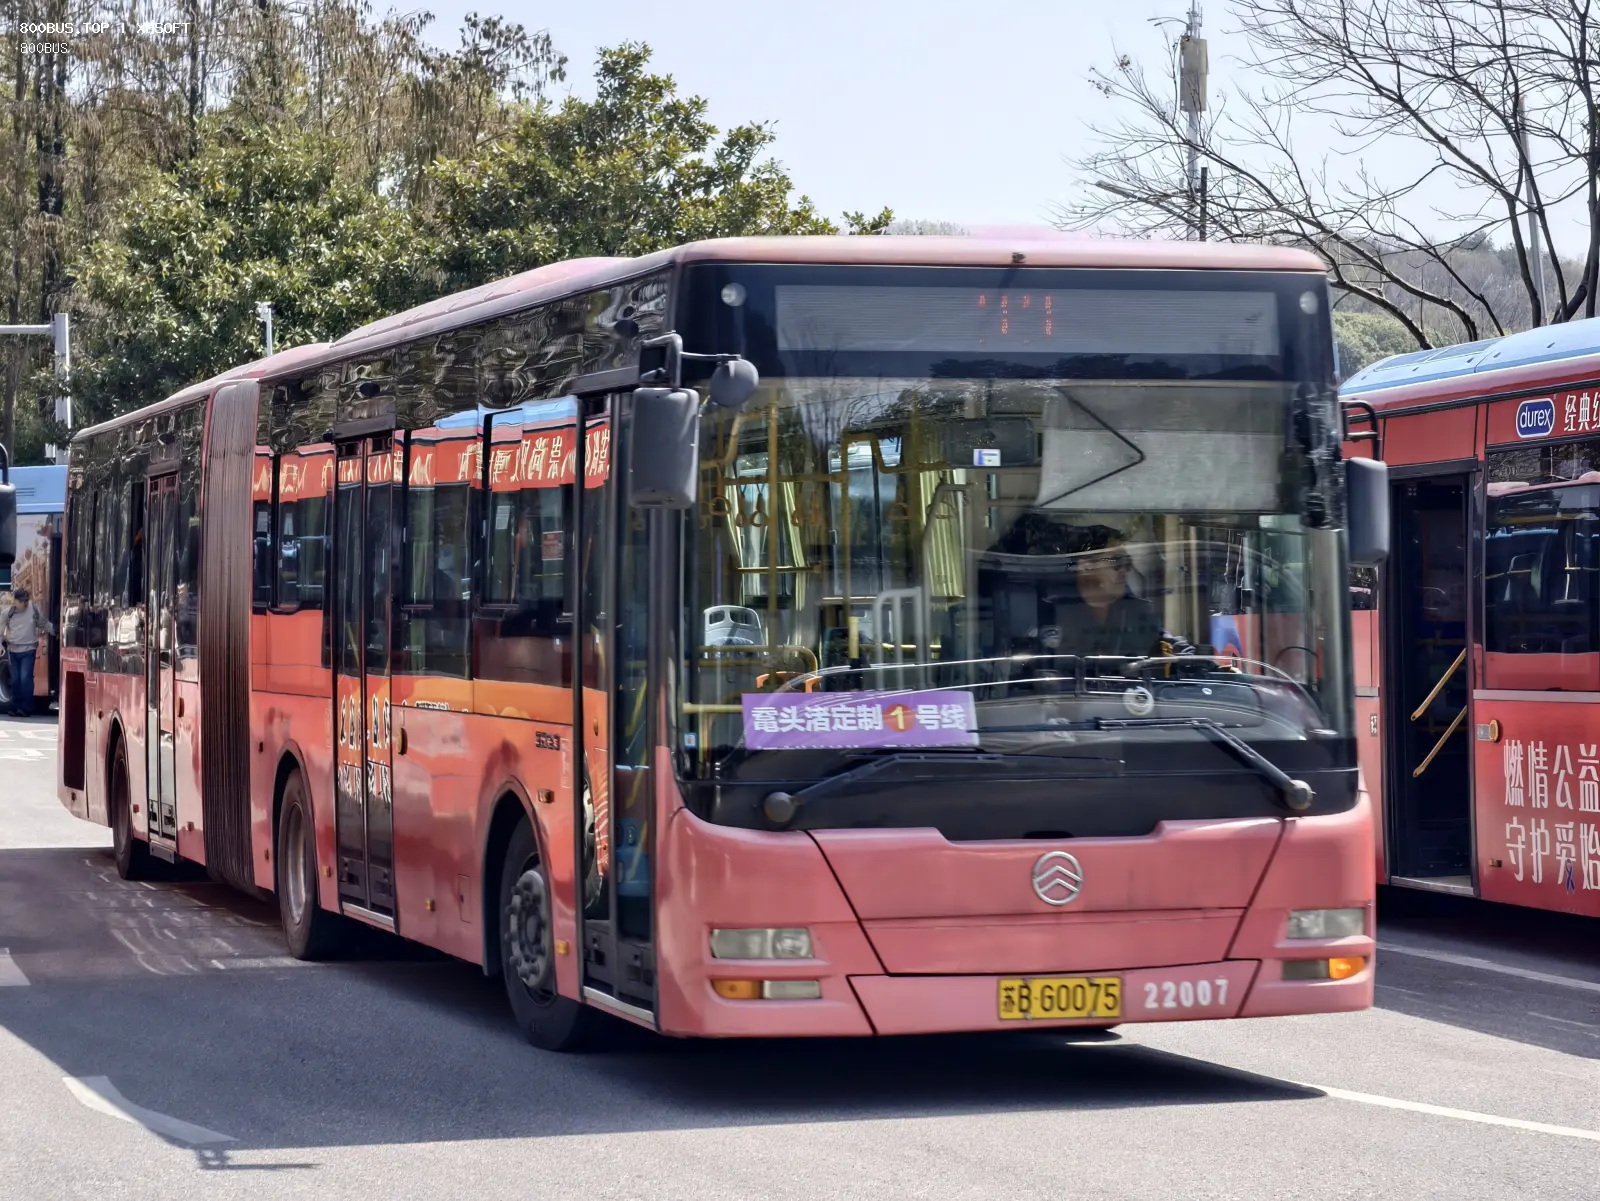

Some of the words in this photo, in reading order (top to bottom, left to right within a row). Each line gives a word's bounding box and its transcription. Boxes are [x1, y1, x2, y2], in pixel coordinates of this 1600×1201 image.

[1519, 405, 1552, 429] durex
[1563, 391, 1600, 432] 经典
[1503, 738, 1600, 813] 燃情公益
[1143, 978, 1229, 1009] 22007
